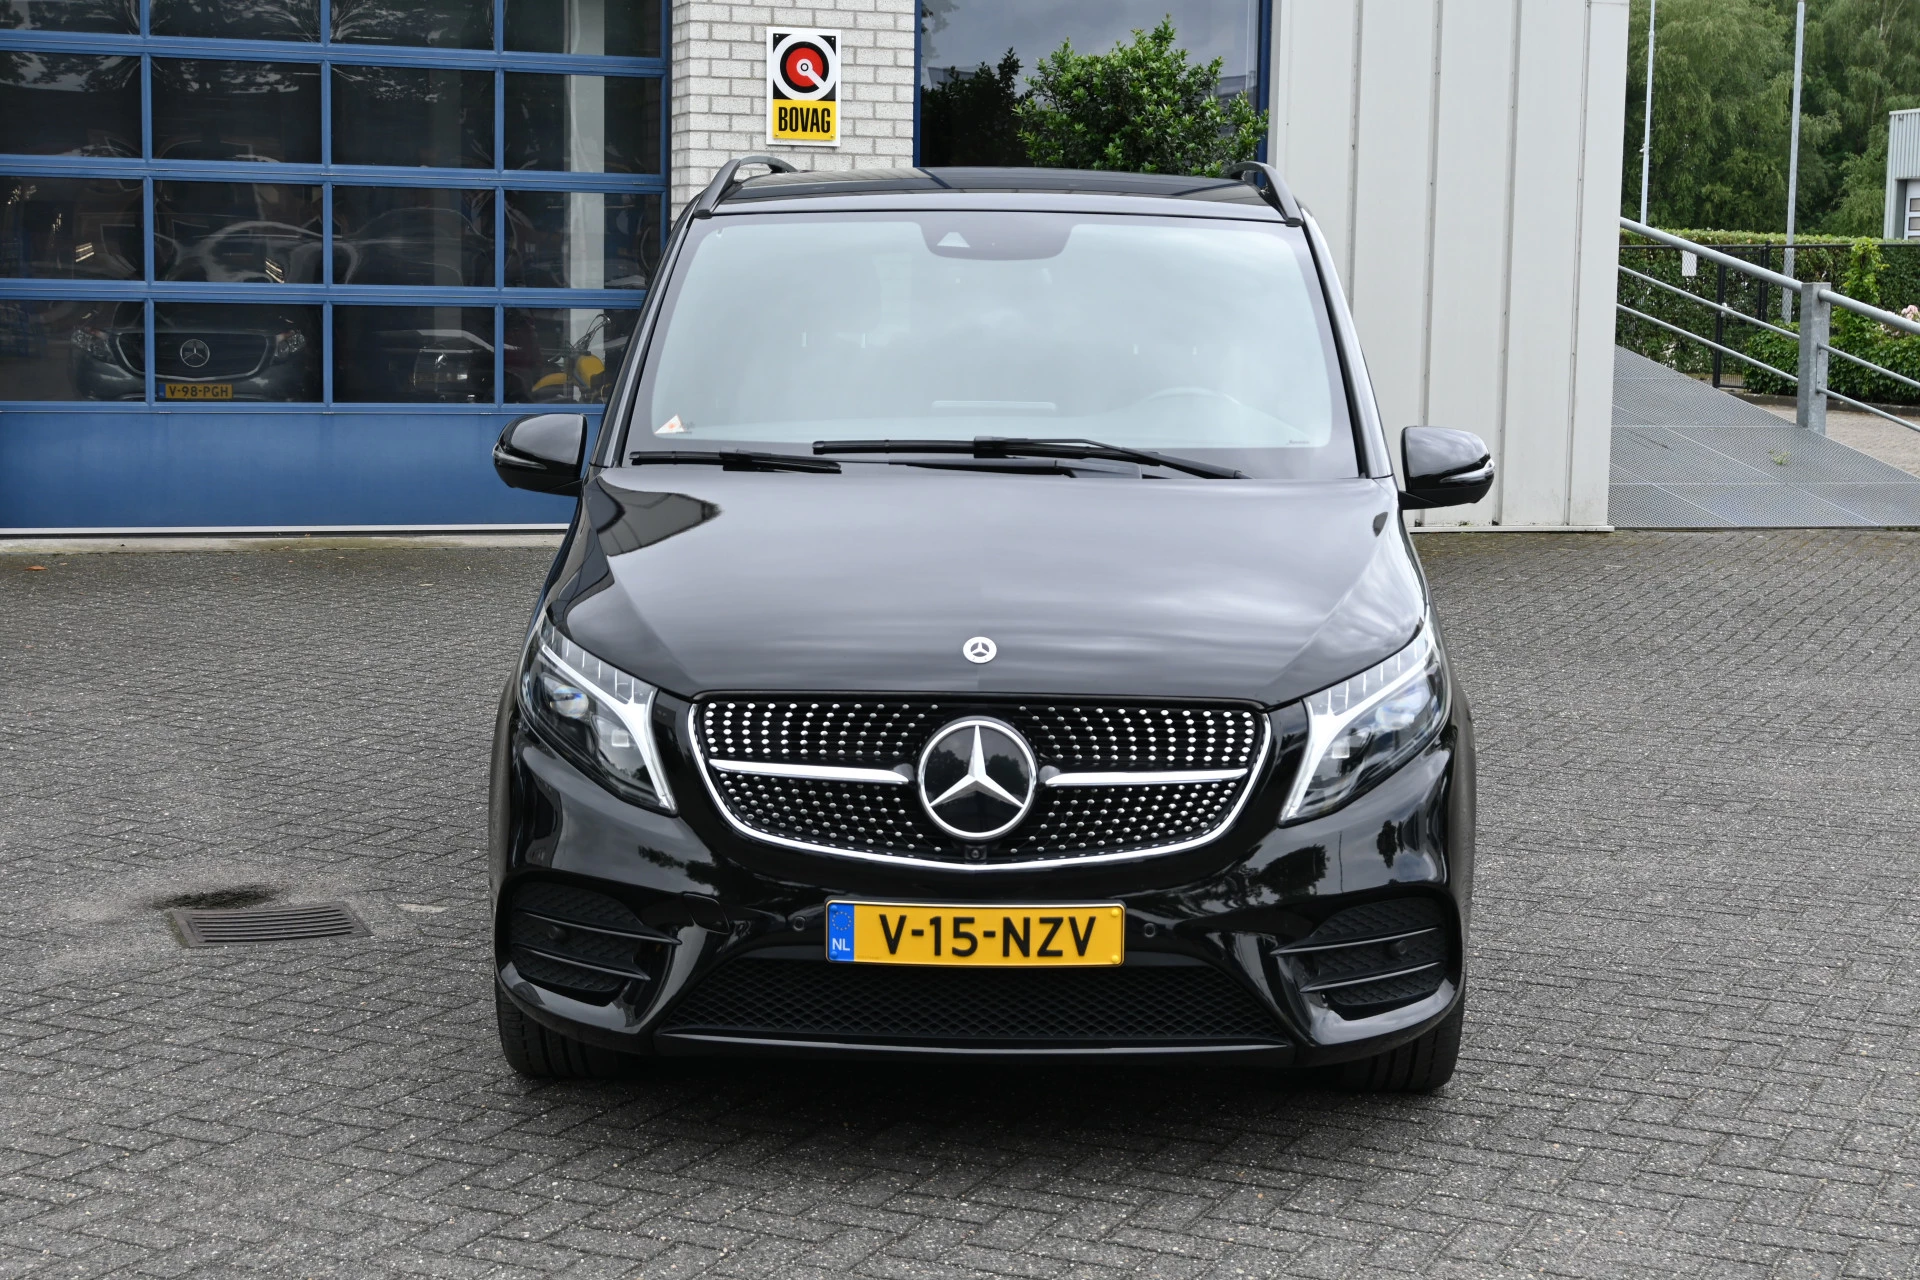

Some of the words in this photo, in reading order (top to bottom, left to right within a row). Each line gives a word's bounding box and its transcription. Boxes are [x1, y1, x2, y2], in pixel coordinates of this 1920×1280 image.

[778, 106, 831, 133] BOVAG
[168, 385, 229, 397] V-98-PGH
[832, 937, 850, 951] NL
[879, 914, 1097, 957] V-15-NZV
